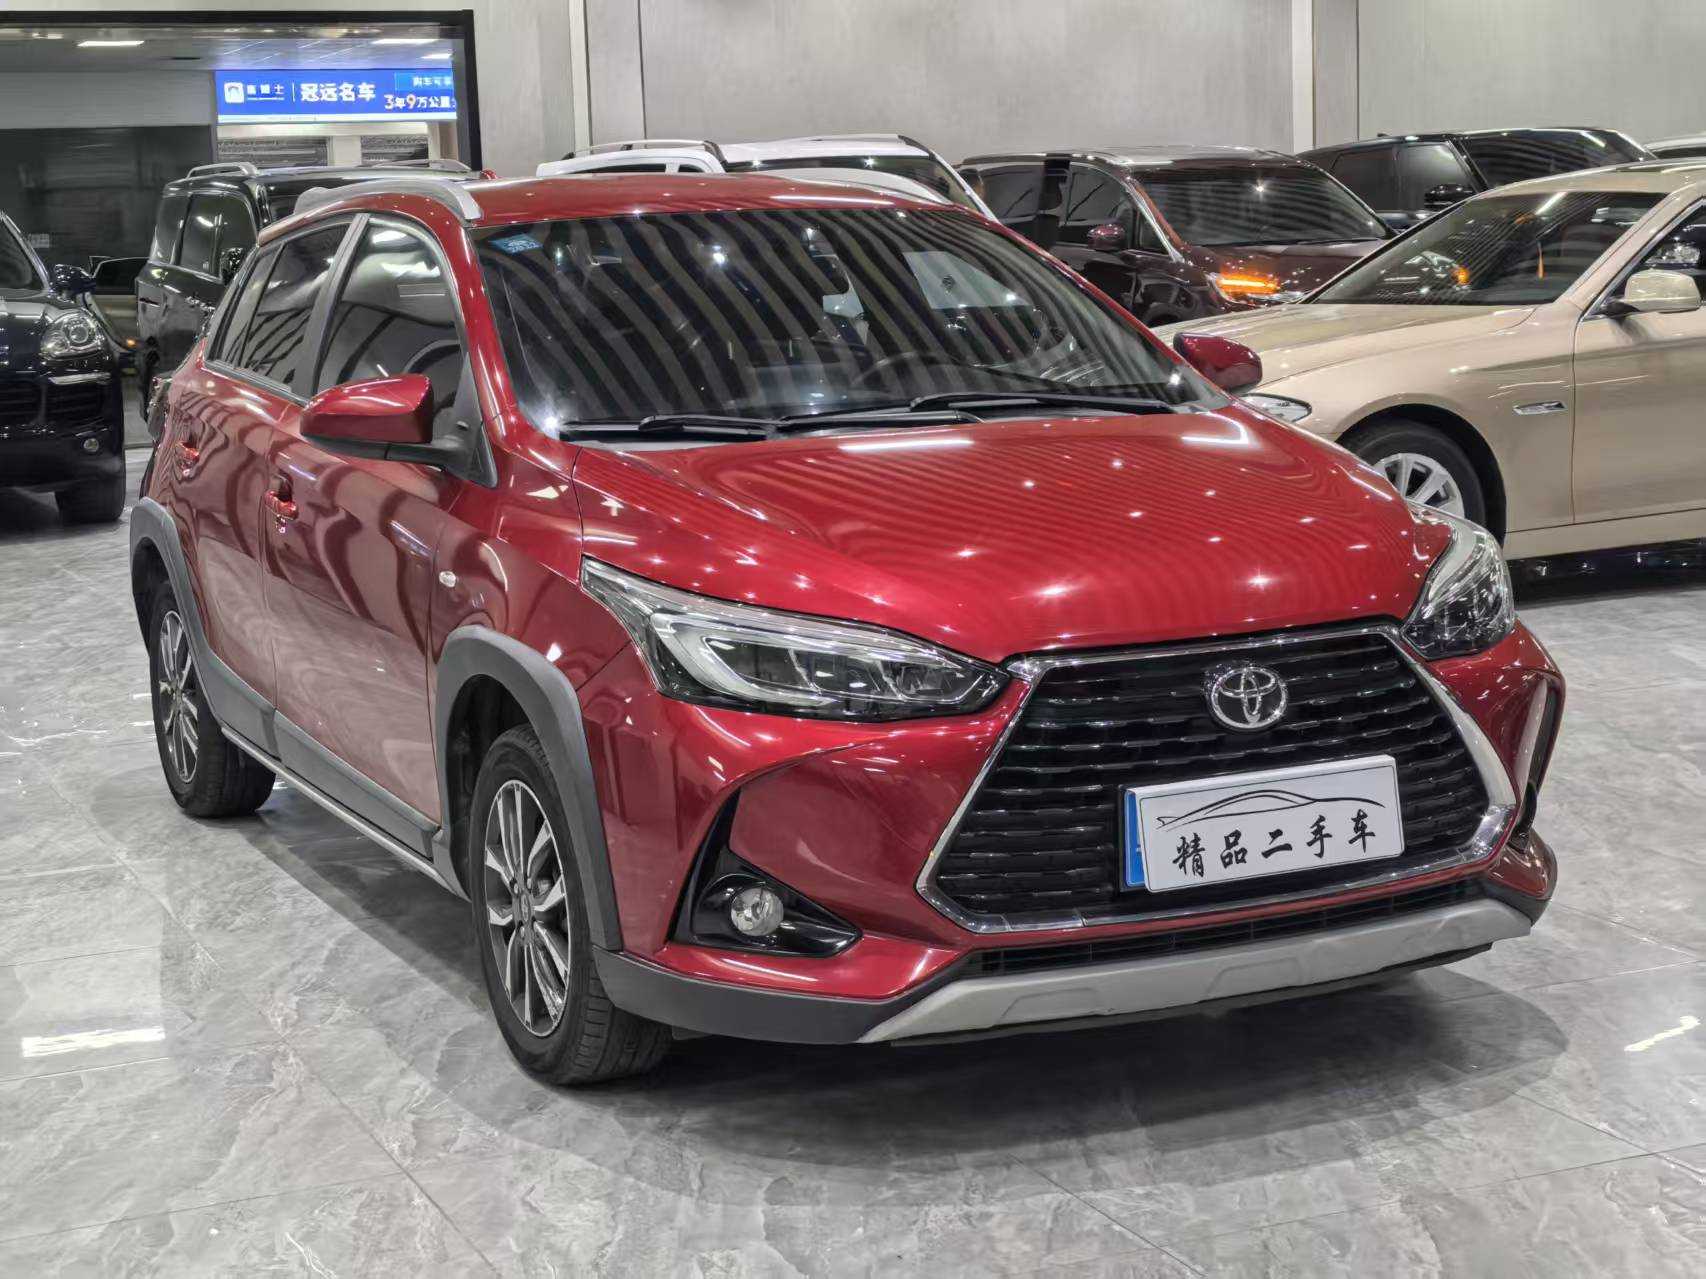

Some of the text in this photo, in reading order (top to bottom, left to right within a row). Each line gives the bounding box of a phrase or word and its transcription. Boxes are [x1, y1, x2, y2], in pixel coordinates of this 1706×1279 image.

[300, 82, 376, 102] 冠远名车
[1172, 809, 1376, 878] 精品二手车
